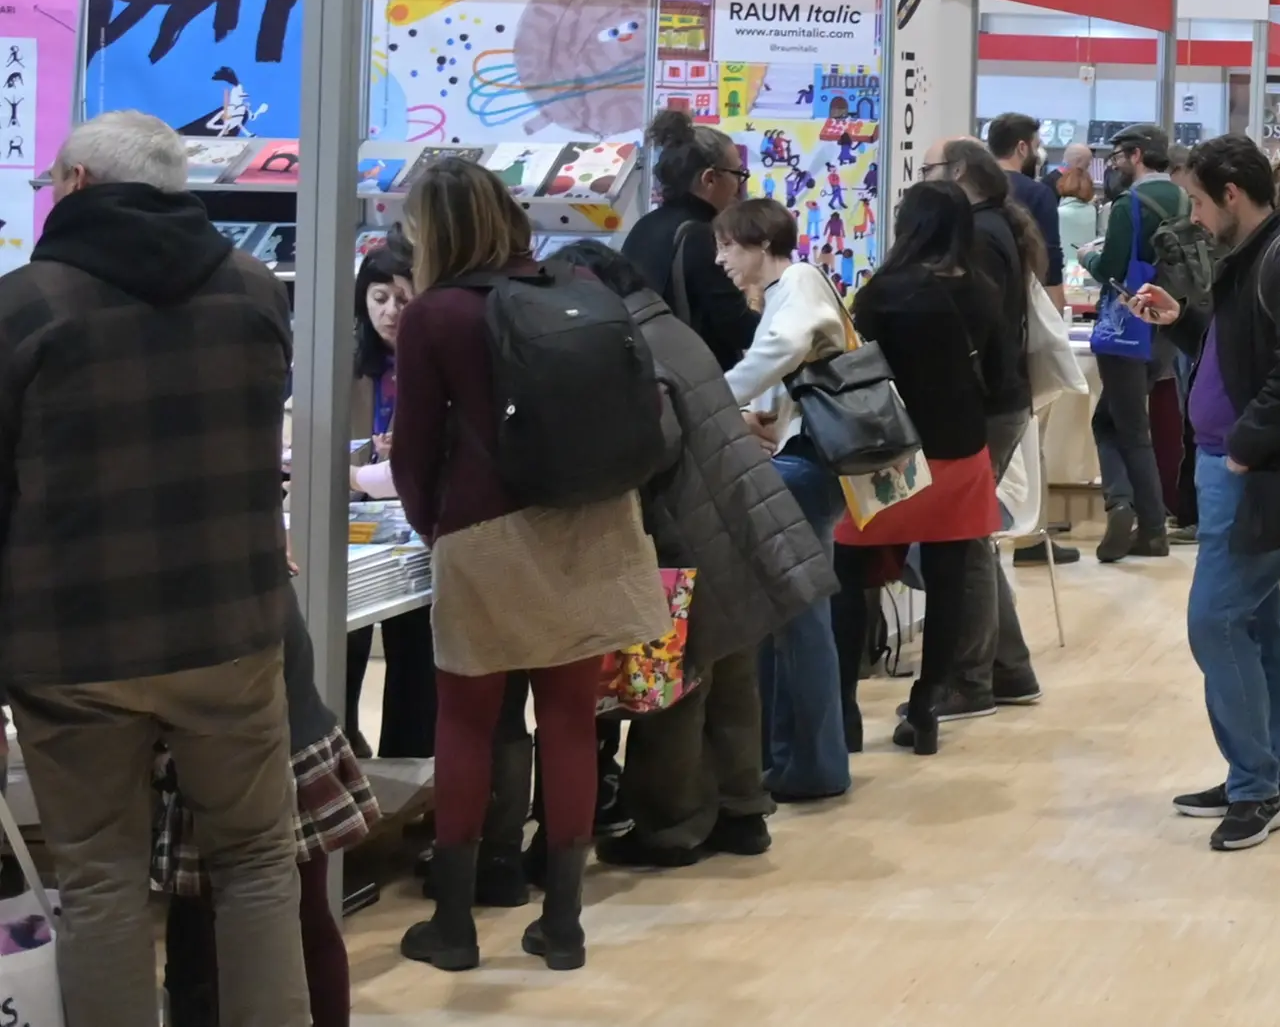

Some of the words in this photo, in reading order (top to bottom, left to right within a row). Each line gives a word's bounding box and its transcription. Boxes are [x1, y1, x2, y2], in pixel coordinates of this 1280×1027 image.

[729, 2, 800, 23] RAUM
[806, 4, 861, 24] Italic
[735, 27, 854, 39] www.raumitalic.com
